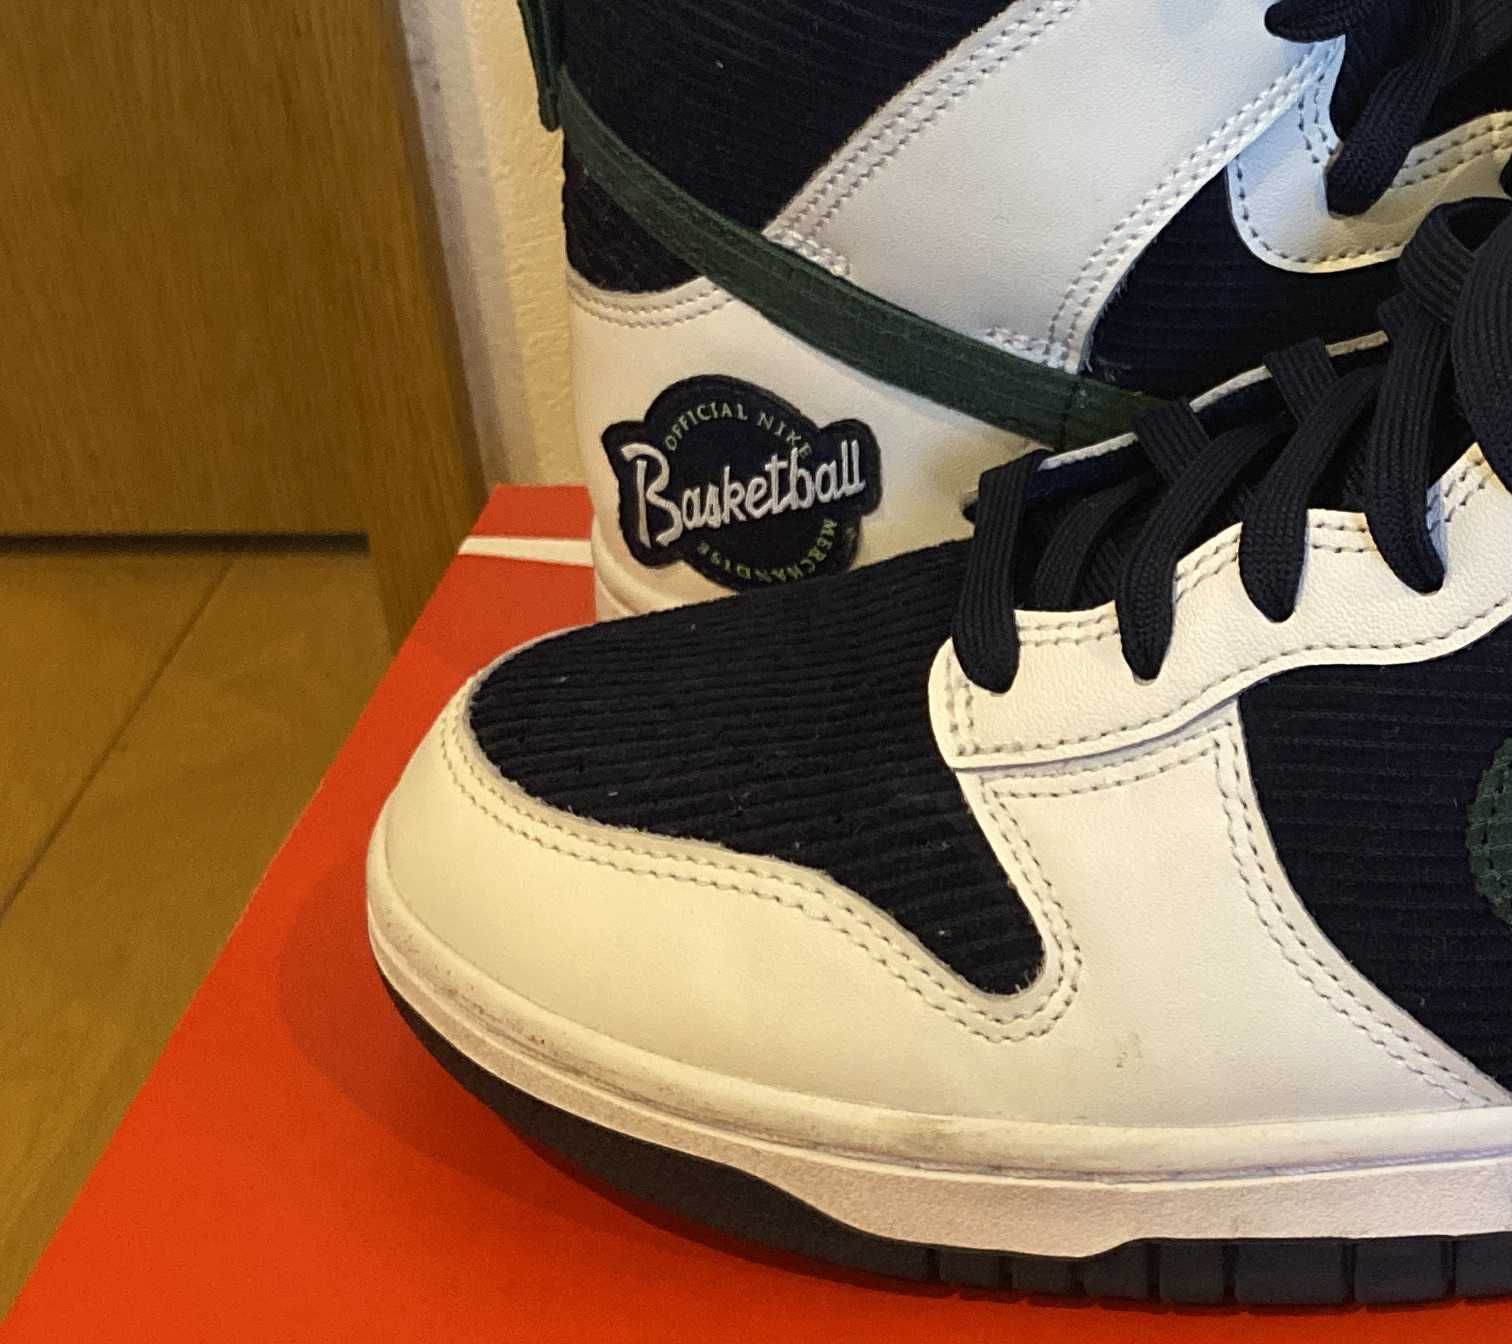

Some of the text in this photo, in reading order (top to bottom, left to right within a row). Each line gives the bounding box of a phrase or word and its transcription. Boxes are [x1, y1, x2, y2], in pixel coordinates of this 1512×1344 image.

[664, 401, 813, 460] OFFICIAL NIKE
[621, 439, 867, 549] Basketball
